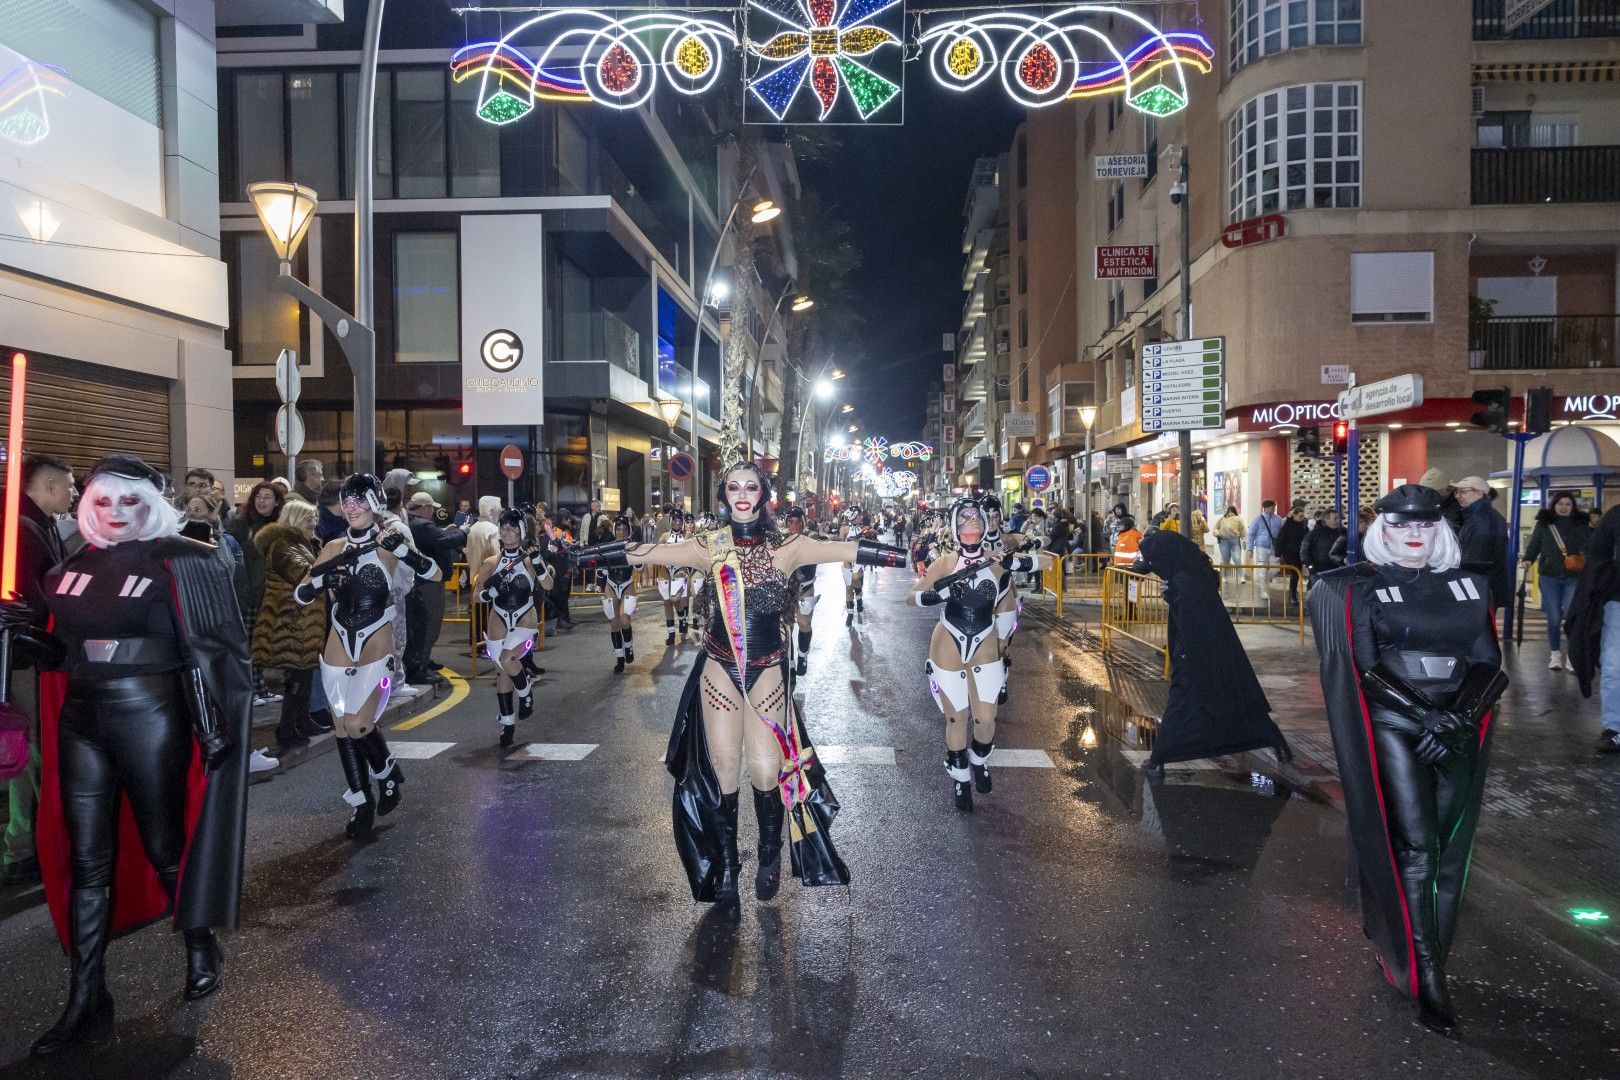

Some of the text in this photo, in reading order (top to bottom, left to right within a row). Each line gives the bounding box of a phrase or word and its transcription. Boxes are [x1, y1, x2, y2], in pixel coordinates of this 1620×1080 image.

[1108, 156, 1146, 166] ASESORIA
[1097, 167, 1146, 177] TORREVIEJA
[1101, 247, 1149, 257] CLINICA DE
[1103, 257, 1147, 267] ESTETICA
[1099, 266, 1153, 277] Y NUTRICION
[1366, 384, 1398, 400] agencia de
[1154, 396, 1160, 404] P
[1365, 391, 1412, 410] desarrollo local
[1154, 420, 1160, 428] P
